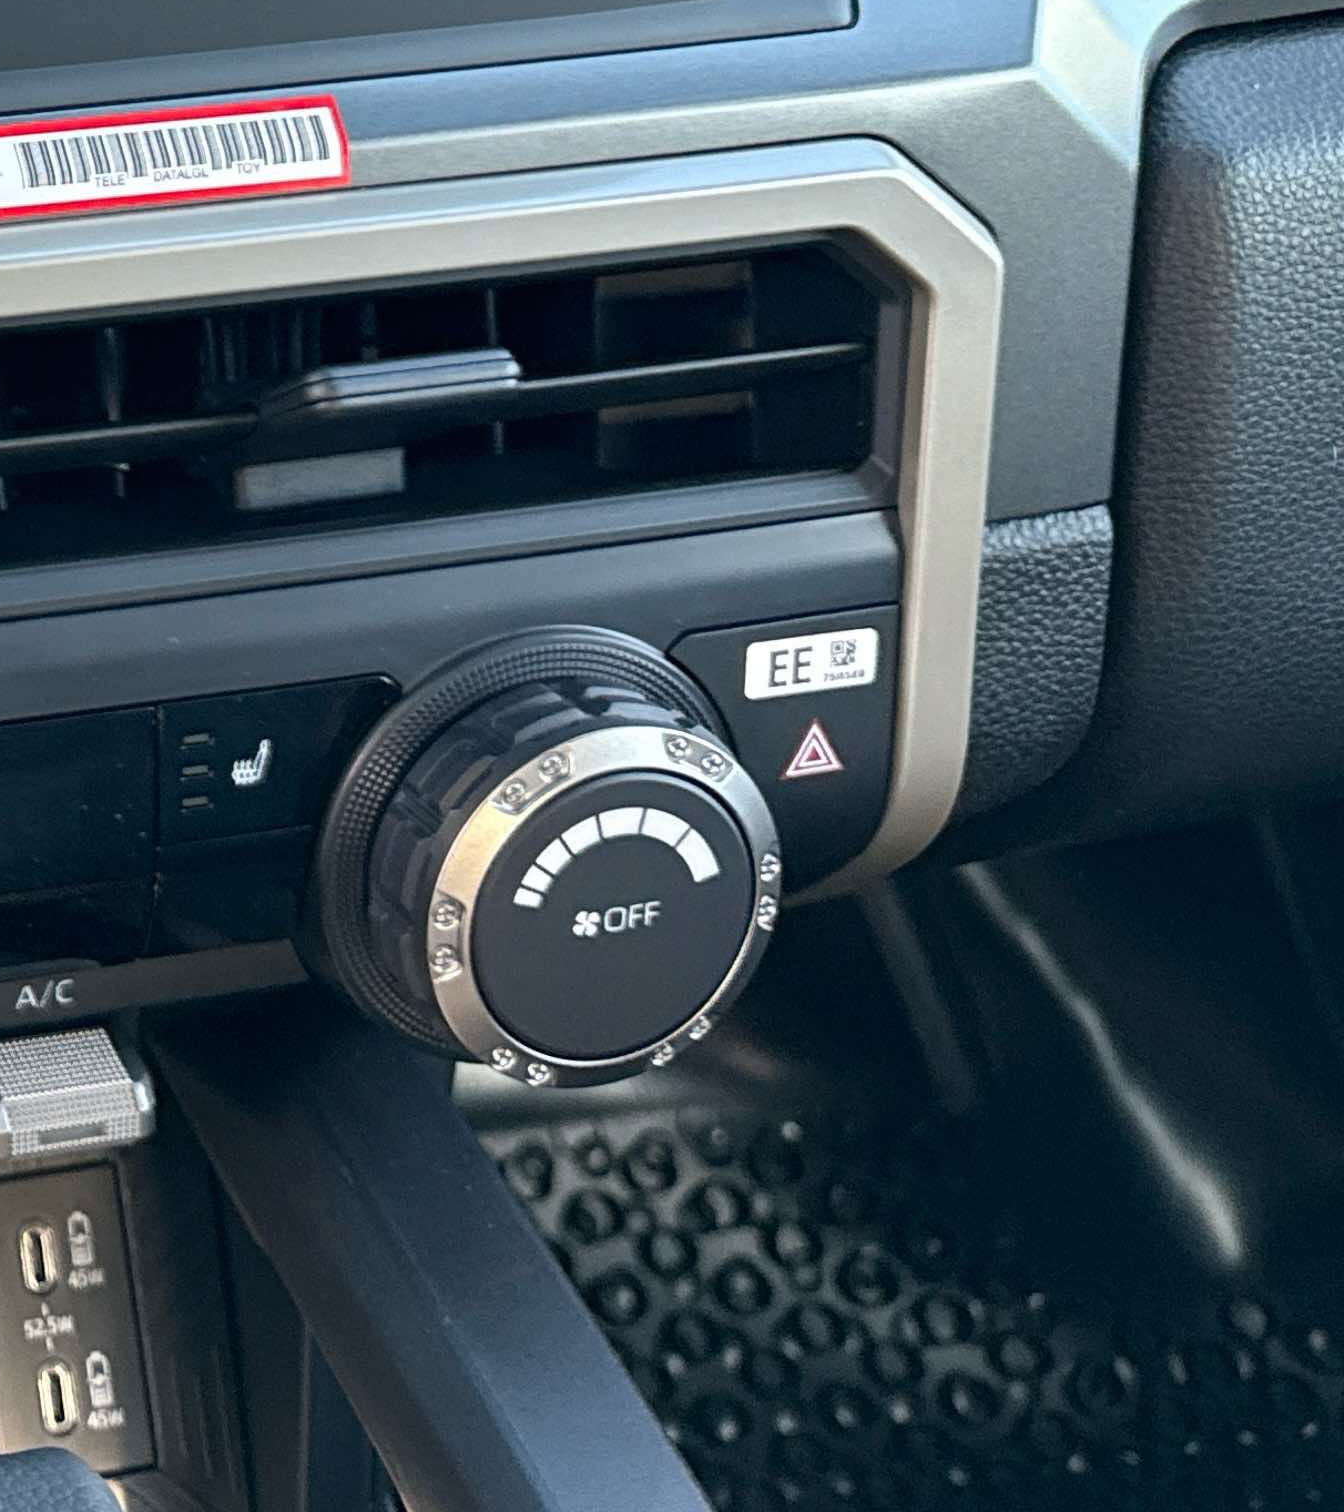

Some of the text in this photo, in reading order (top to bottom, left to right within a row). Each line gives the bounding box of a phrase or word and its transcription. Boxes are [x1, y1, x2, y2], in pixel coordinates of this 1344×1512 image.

[95, 174, 126, 187] TELE
[768, 646, 813, 688] EE
[603, 900, 661, 933] OFF
[15, 978, 76, 1010] A/C
